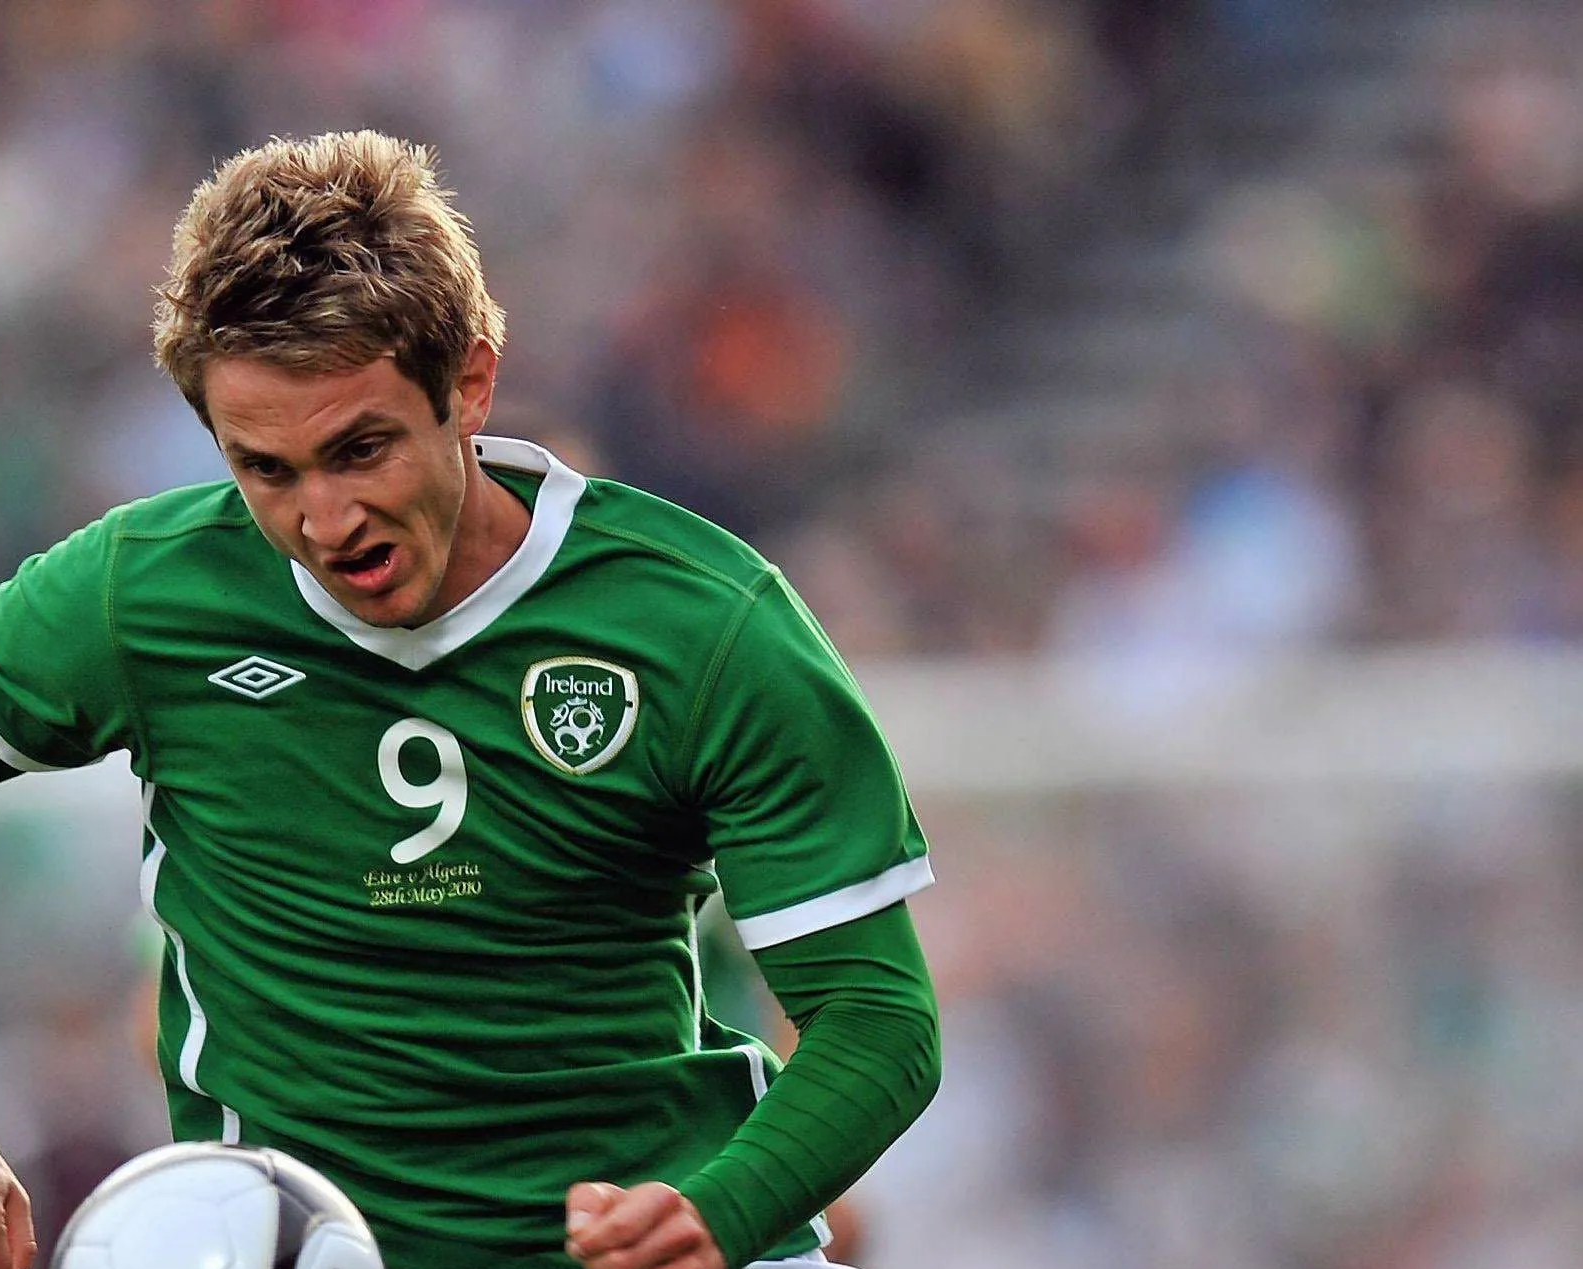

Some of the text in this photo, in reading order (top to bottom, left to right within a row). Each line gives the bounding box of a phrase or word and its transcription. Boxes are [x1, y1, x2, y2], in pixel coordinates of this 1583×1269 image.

[544, 672, 613, 696] Ireland
[377, 718, 468, 865] 9
[418, 861, 480, 884] Algeria
[408, 886, 445, 905] May
[448, 880, 482, 897] 2010
